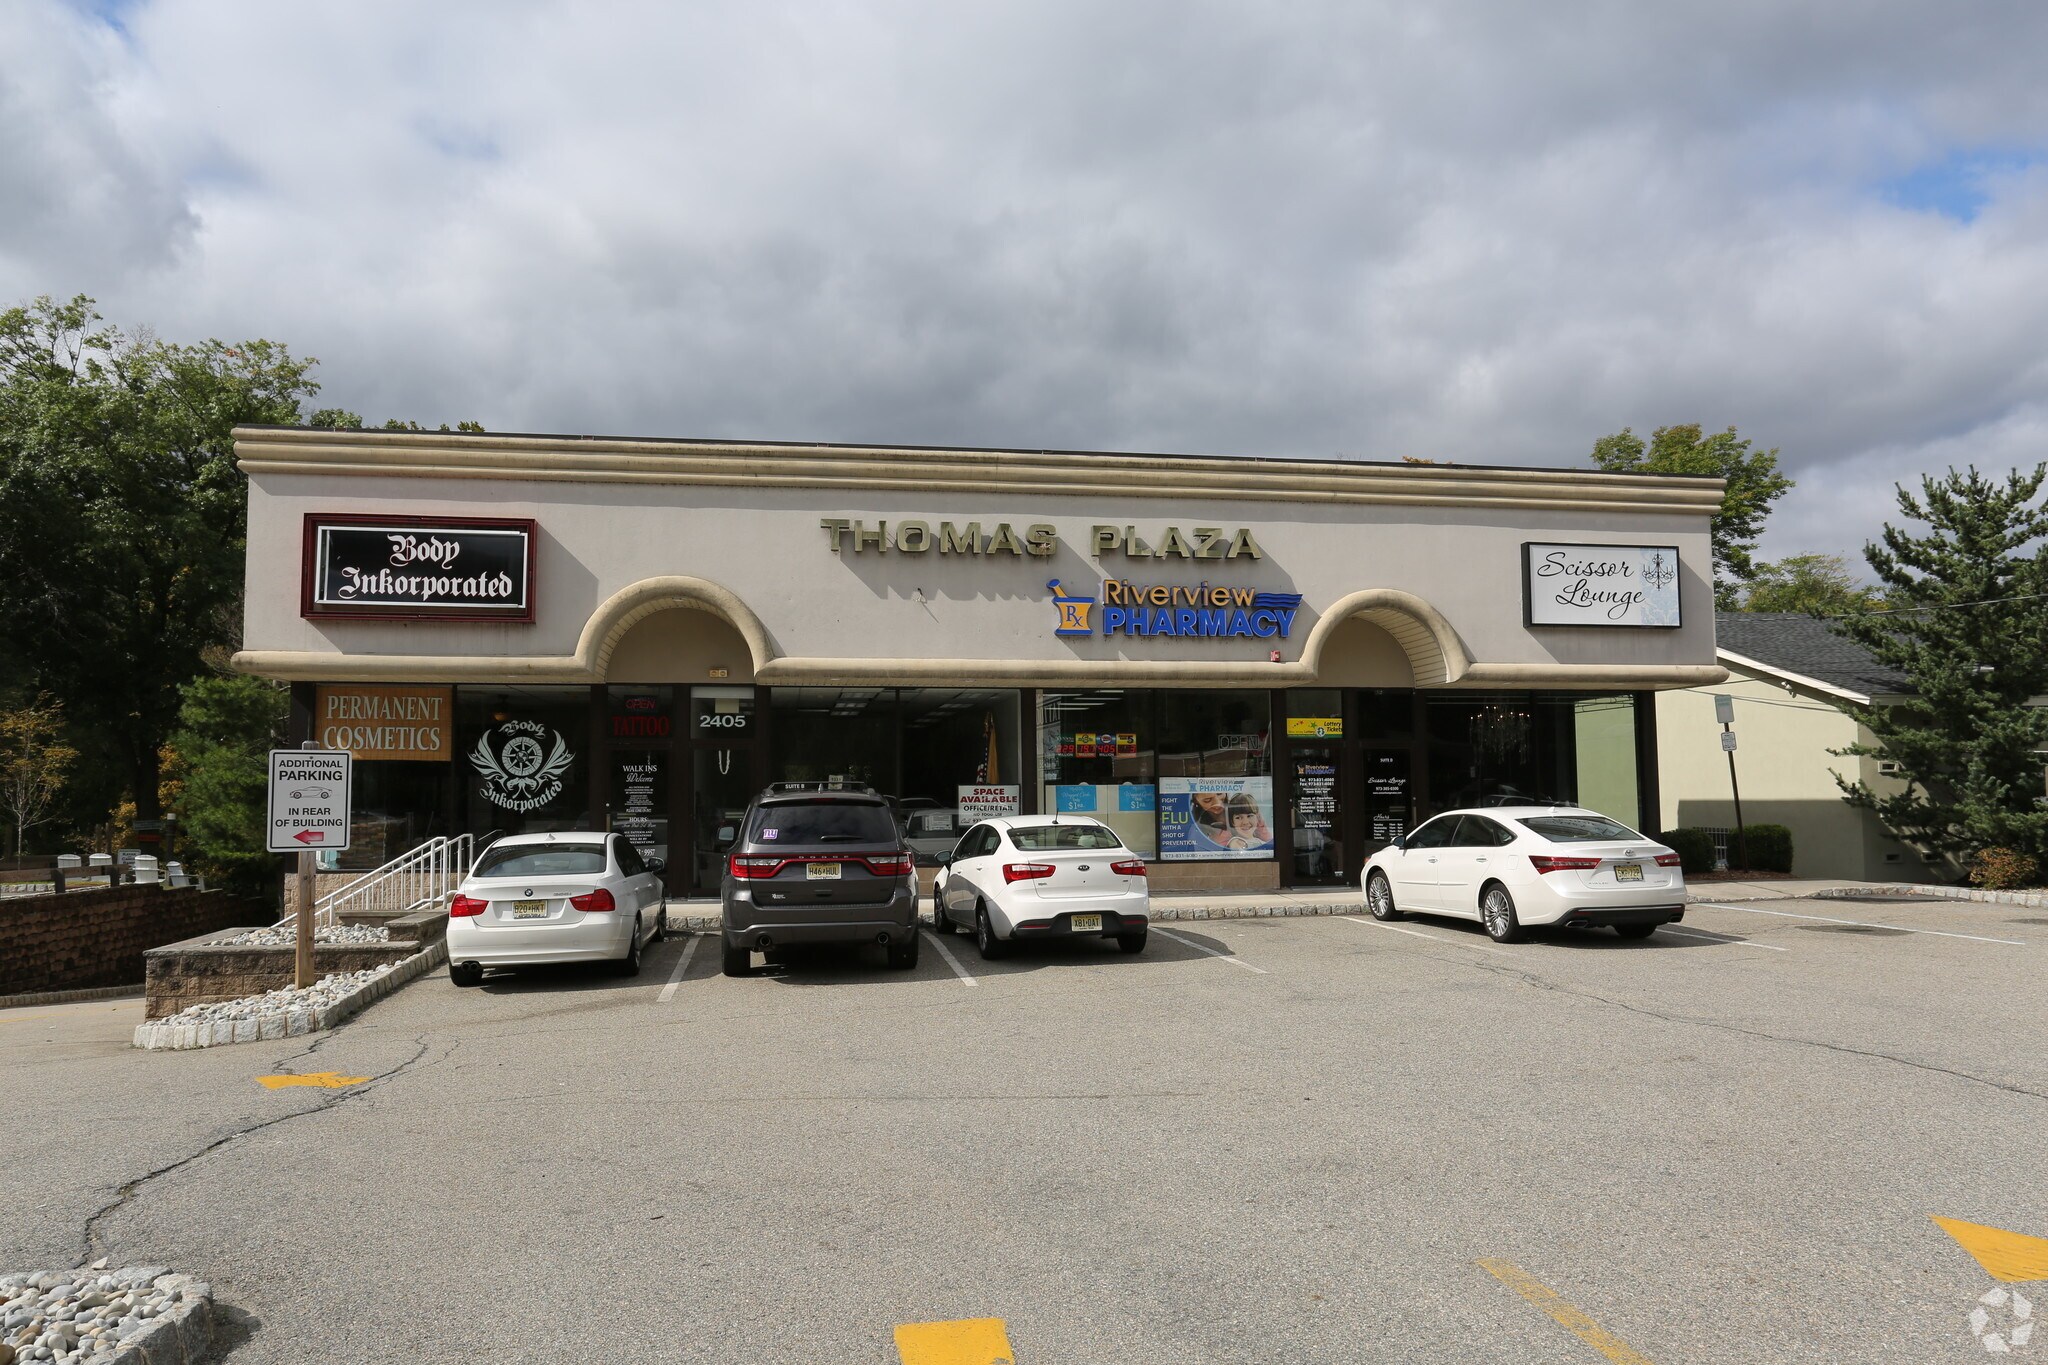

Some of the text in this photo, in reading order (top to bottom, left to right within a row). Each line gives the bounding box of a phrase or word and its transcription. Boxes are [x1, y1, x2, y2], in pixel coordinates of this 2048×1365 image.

[820, 518, 1262, 560] THOMAS PLAZA
[387, 534, 460, 569] Body
[1537, 551, 1634, 578] Scissor
[338, 566, 512, 601] Inkorporated
[1103, 579, 1255, 606] Riverview
[1555, 578, 1645, 620] Lounge
[1103, 608, 1297, 637] PHARMACY
[326, 695, 442, 720] PERMANENT
[625, 699, 656, 709] OPEN
[498, 720, 546, 739] Body
[612, 716, 670, 736] TATTOO
[700, 715, 746, 728] 2405
[323, 726, 441, 750] COSMETICS
[1220, 736, 1258, 749] OPEN
[278, 760, 343, 768] ADDITIONAL
[278, 770, 343, 781] PARKING
[480, 780, 563, 814] Inkorporated
[288, 807, 331, 816] IN REAR
[1161, 811, 1189, 824] FLU
[275, 819, 343, 828] OF BUILDING
